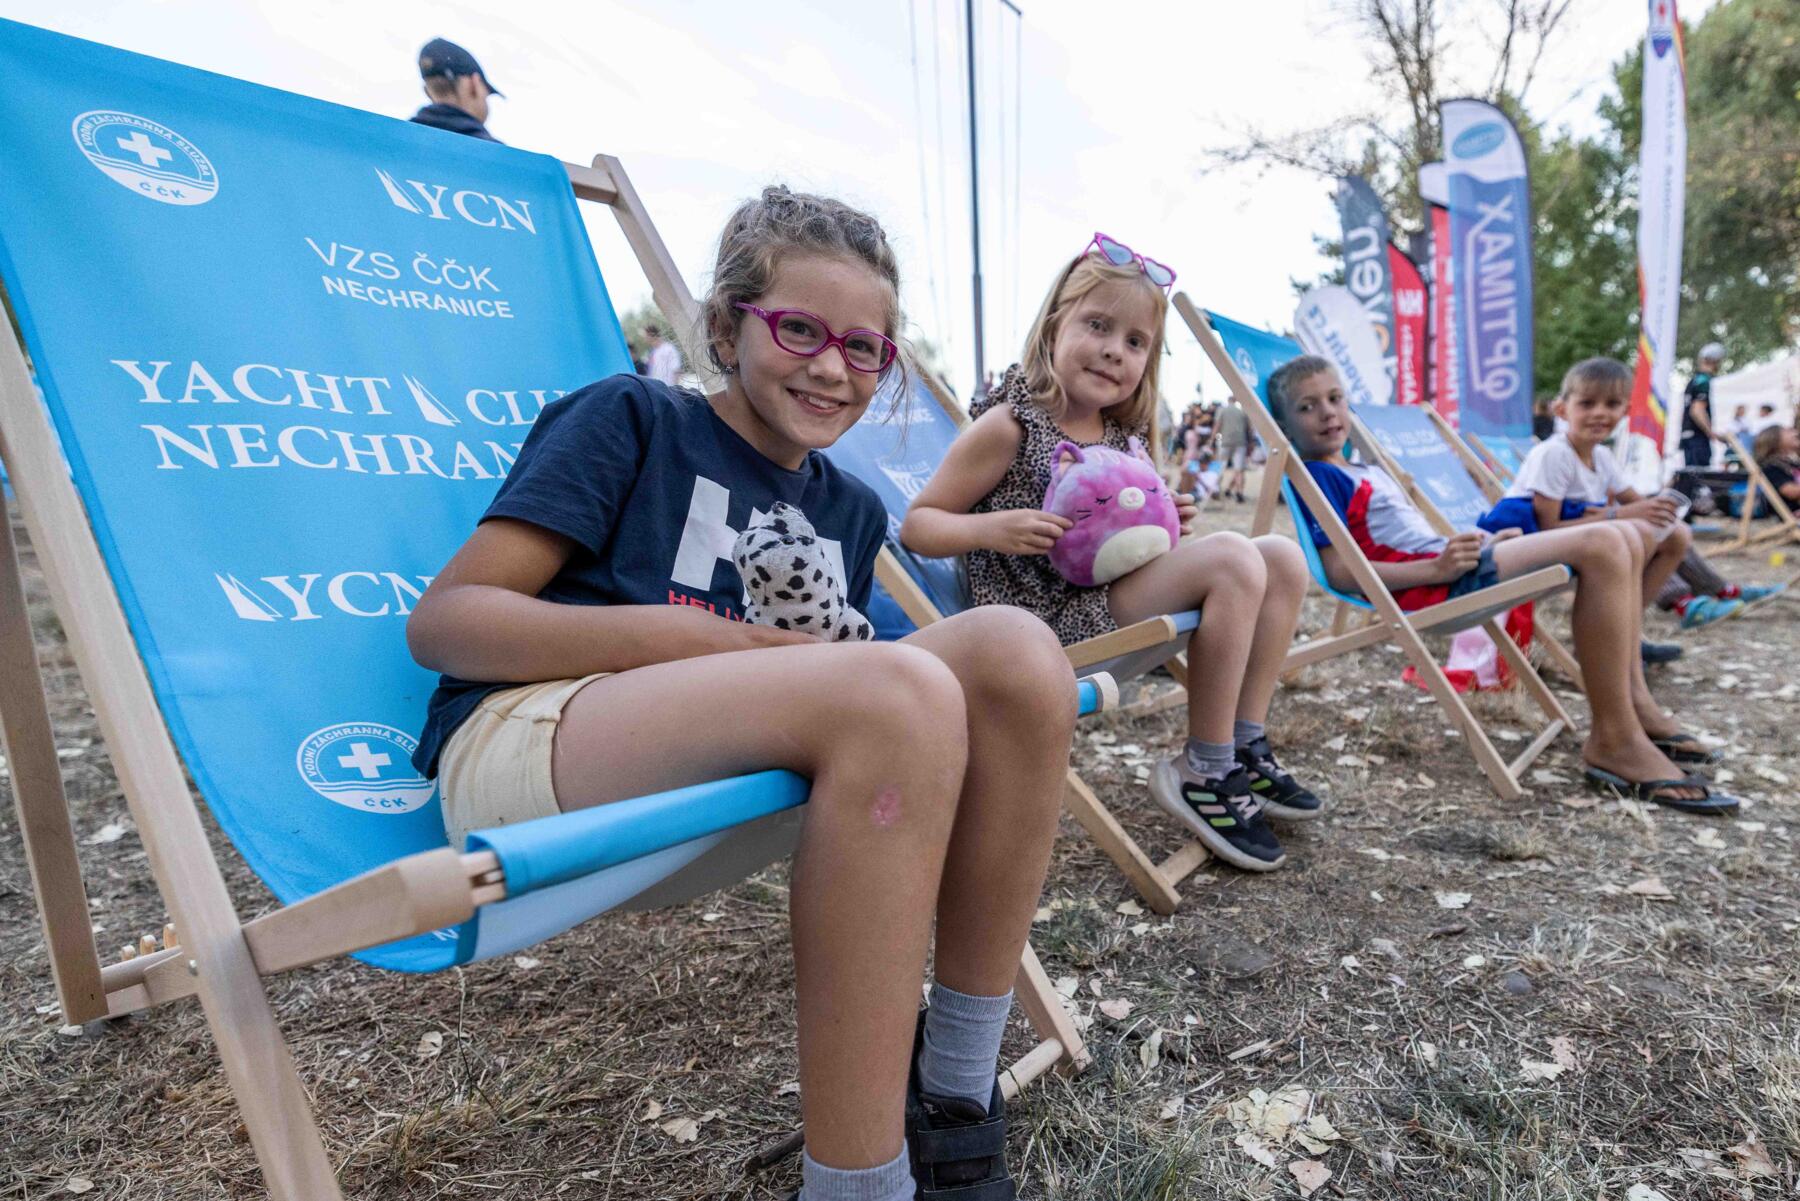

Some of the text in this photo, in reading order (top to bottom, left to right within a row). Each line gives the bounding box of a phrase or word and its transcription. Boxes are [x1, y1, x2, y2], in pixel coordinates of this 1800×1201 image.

[406, 179, 537, 235] YCN
[304, 237, 501, 293] VZS ČČK
[321, 275, 514, 319] NECHRANICE
[110, 360, 572, 426] YACHT CL
[140, 424, 524, 481] NECHRAN
[261, 571, 436, 622] YCN
[394, 735, 418, 753] SLU
